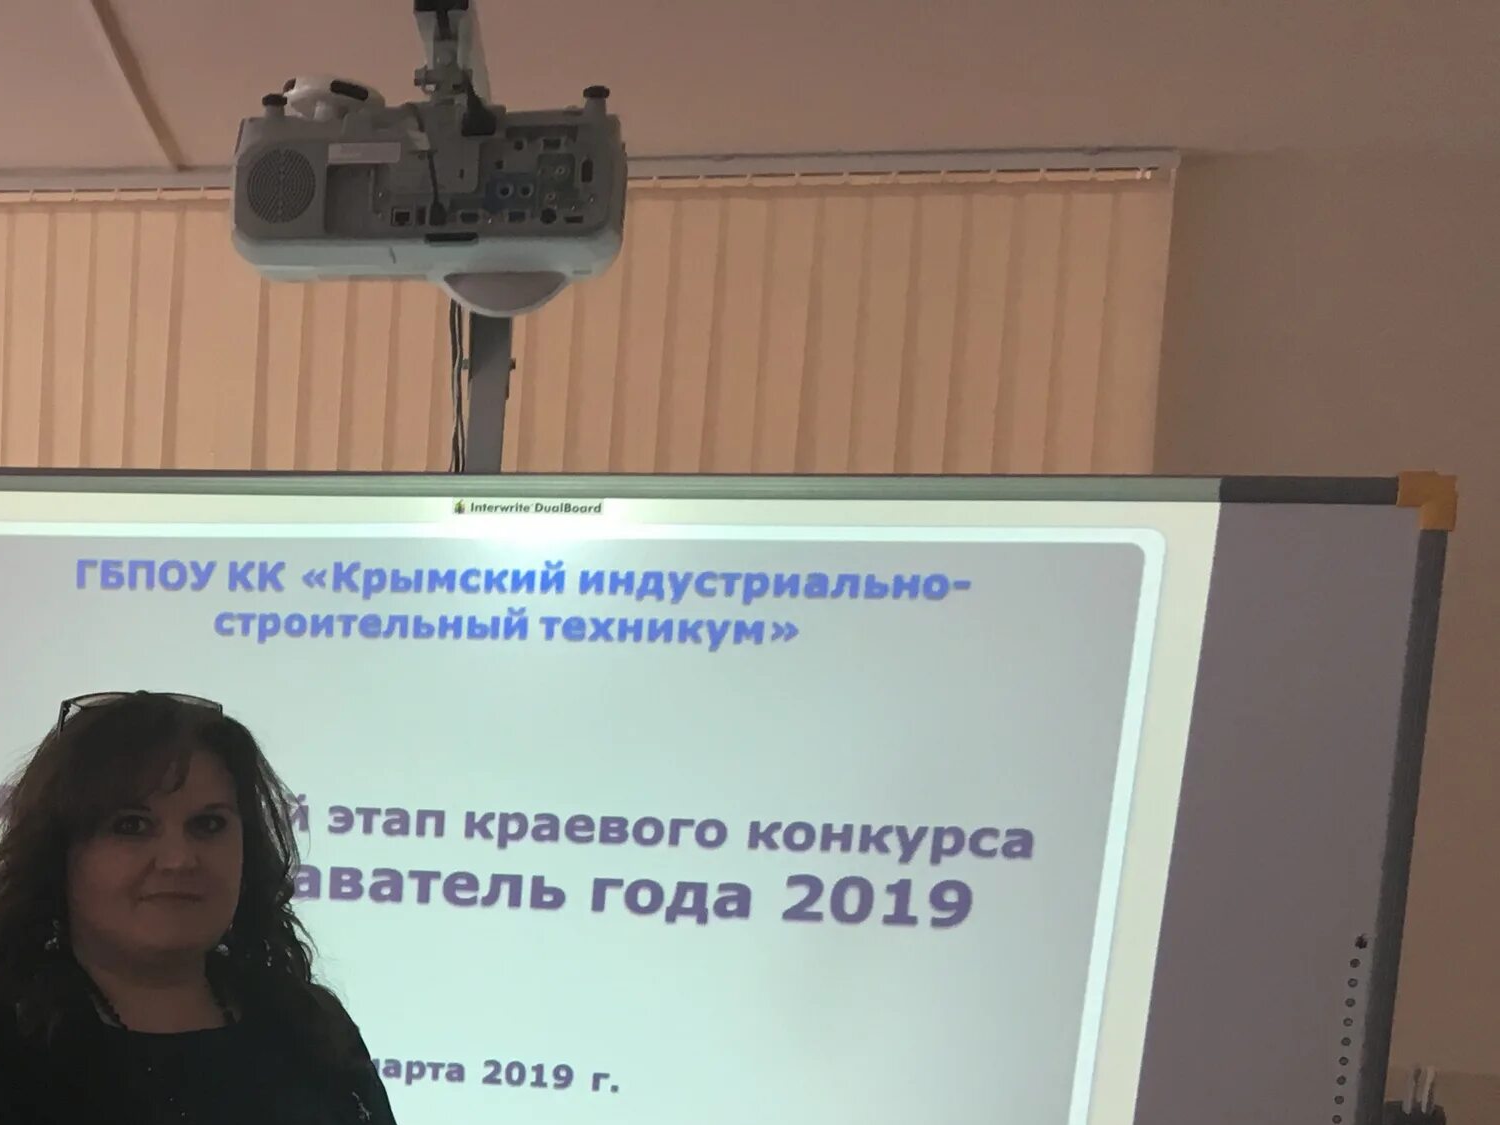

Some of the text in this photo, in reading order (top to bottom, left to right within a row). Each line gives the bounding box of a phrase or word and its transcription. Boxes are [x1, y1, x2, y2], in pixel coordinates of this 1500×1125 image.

[470, 502, 602, 513] Interwrite DualBoard
[76, 558, 972, 606] ГБПОУ КК «Крымский индустриально-
[214, 607, 800, 653] строительный техникум»
[327, 803, 447, 838] этап
[463, 809, 729, 850] краевого
[747, 819, 1035, 866] конкурса
[293, 863, 974, 929] аватель года 2019
[481, 1058, 575, 1091] 2019
[591, 1071, 620, 1094] г.
